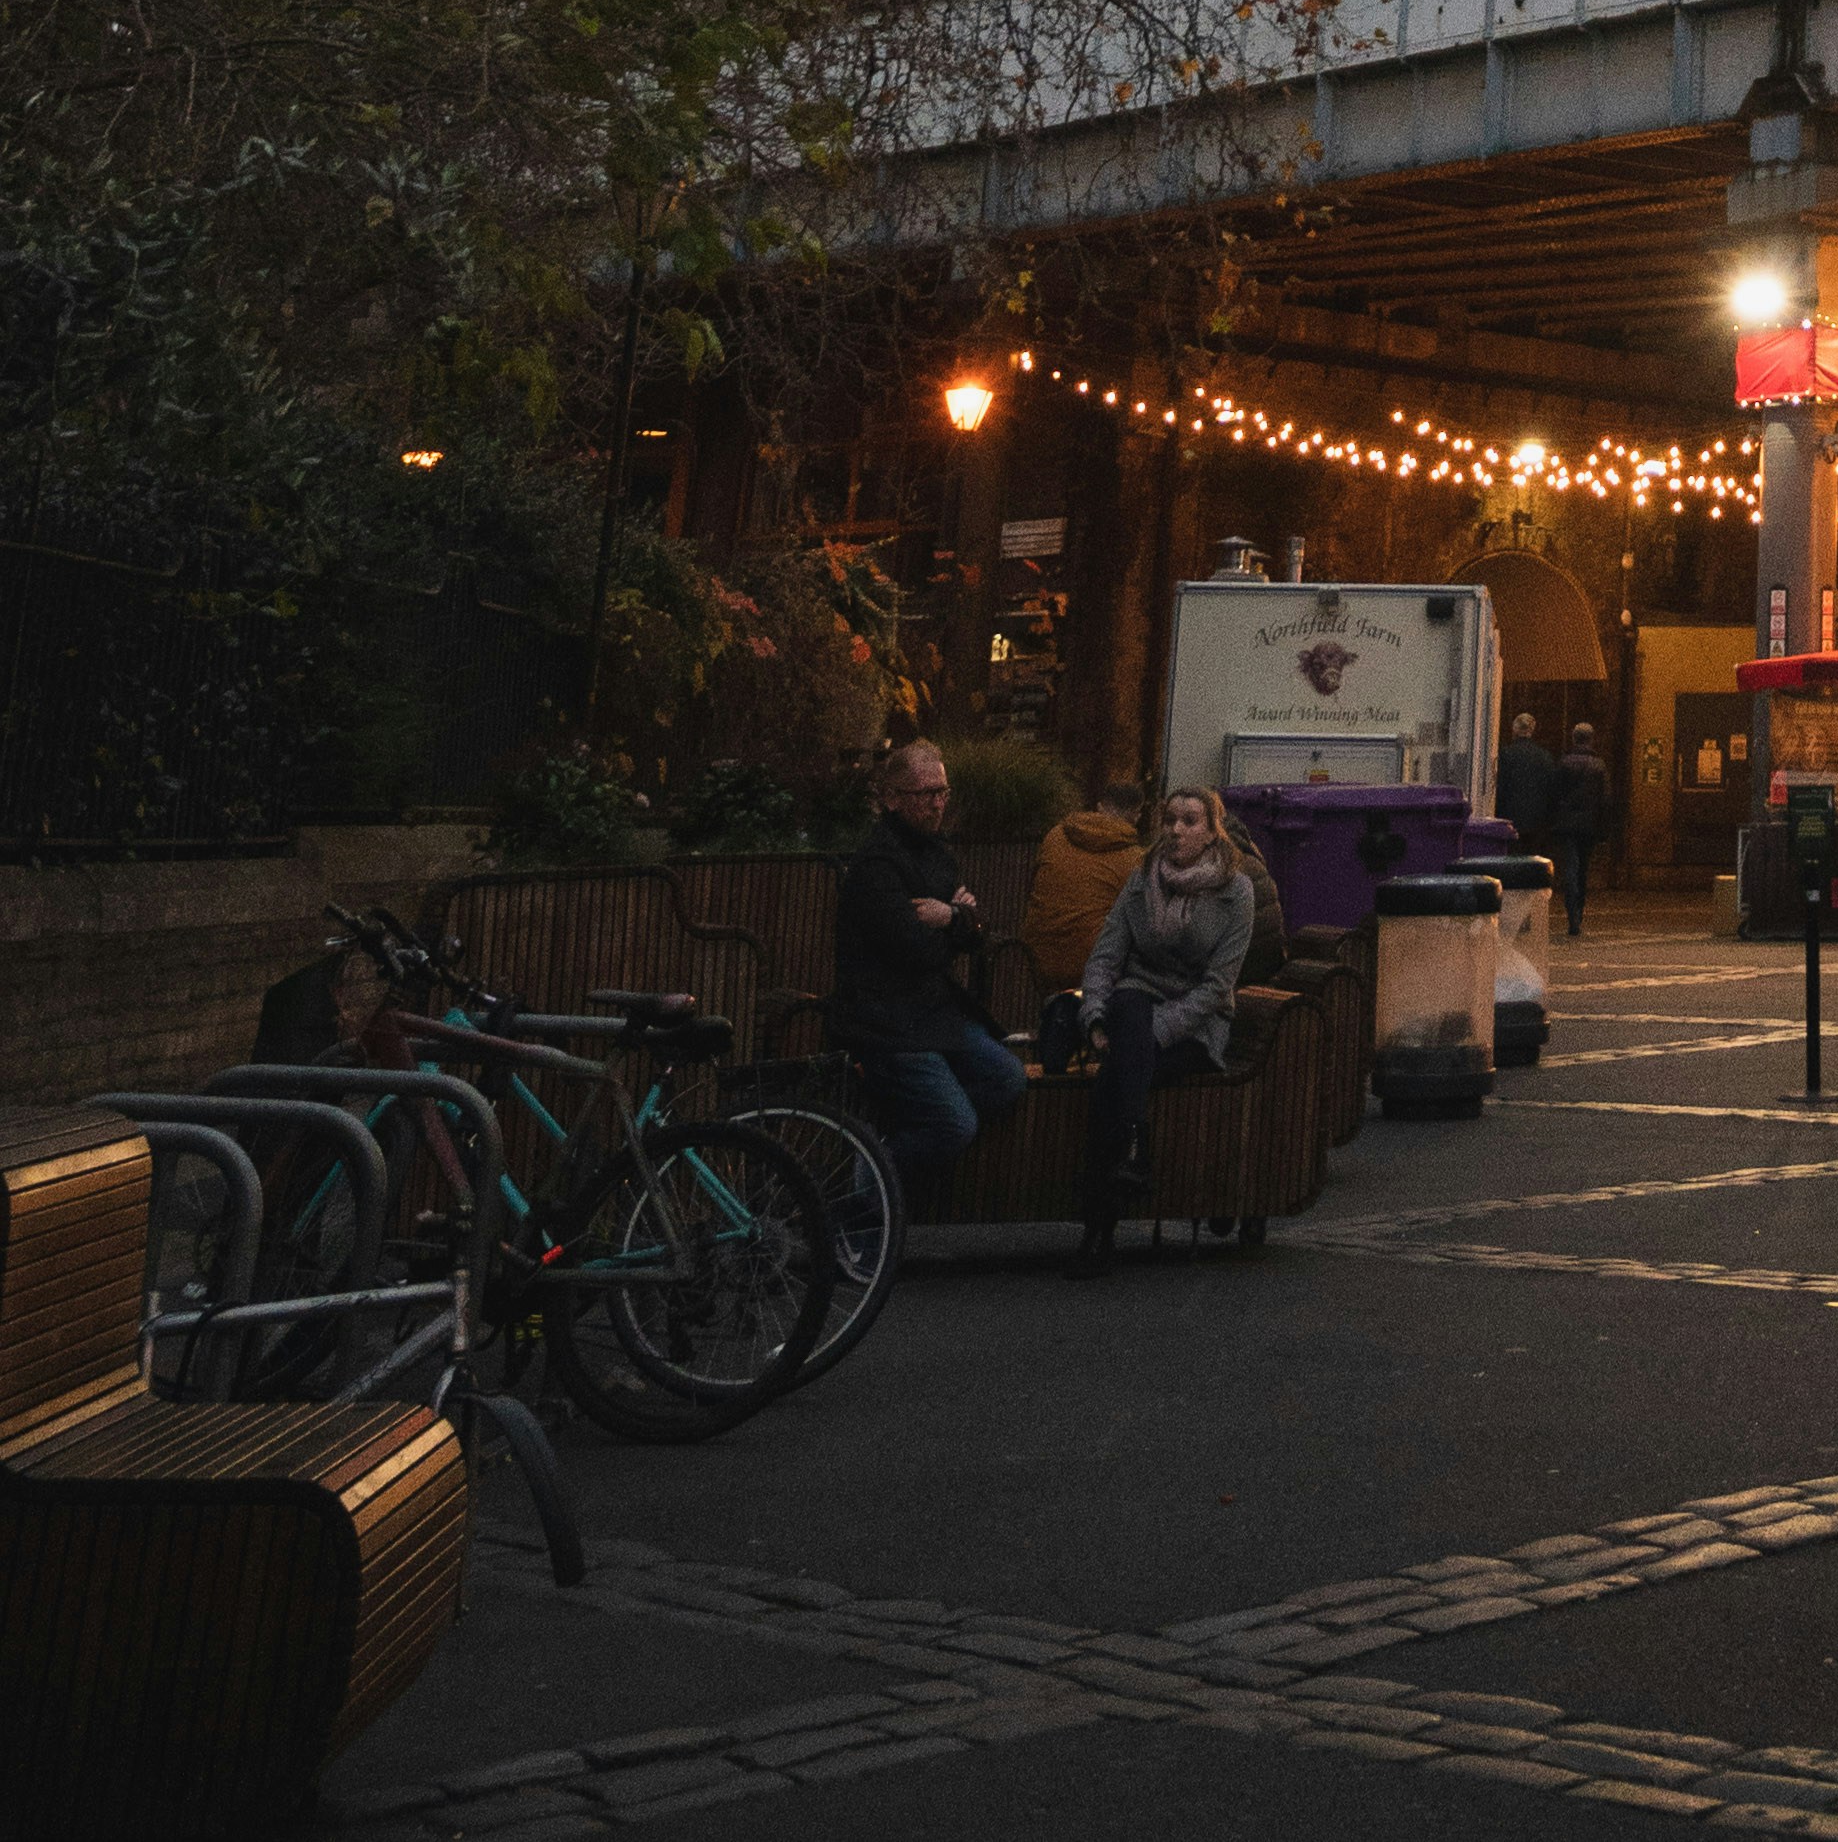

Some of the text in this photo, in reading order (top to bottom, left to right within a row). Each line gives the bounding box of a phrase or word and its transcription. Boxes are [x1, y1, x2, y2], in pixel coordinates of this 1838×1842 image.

[1254, 616, 1402, 649] Northfield Farm
[1245, 701, 1400, 726] Award Winning Meat
